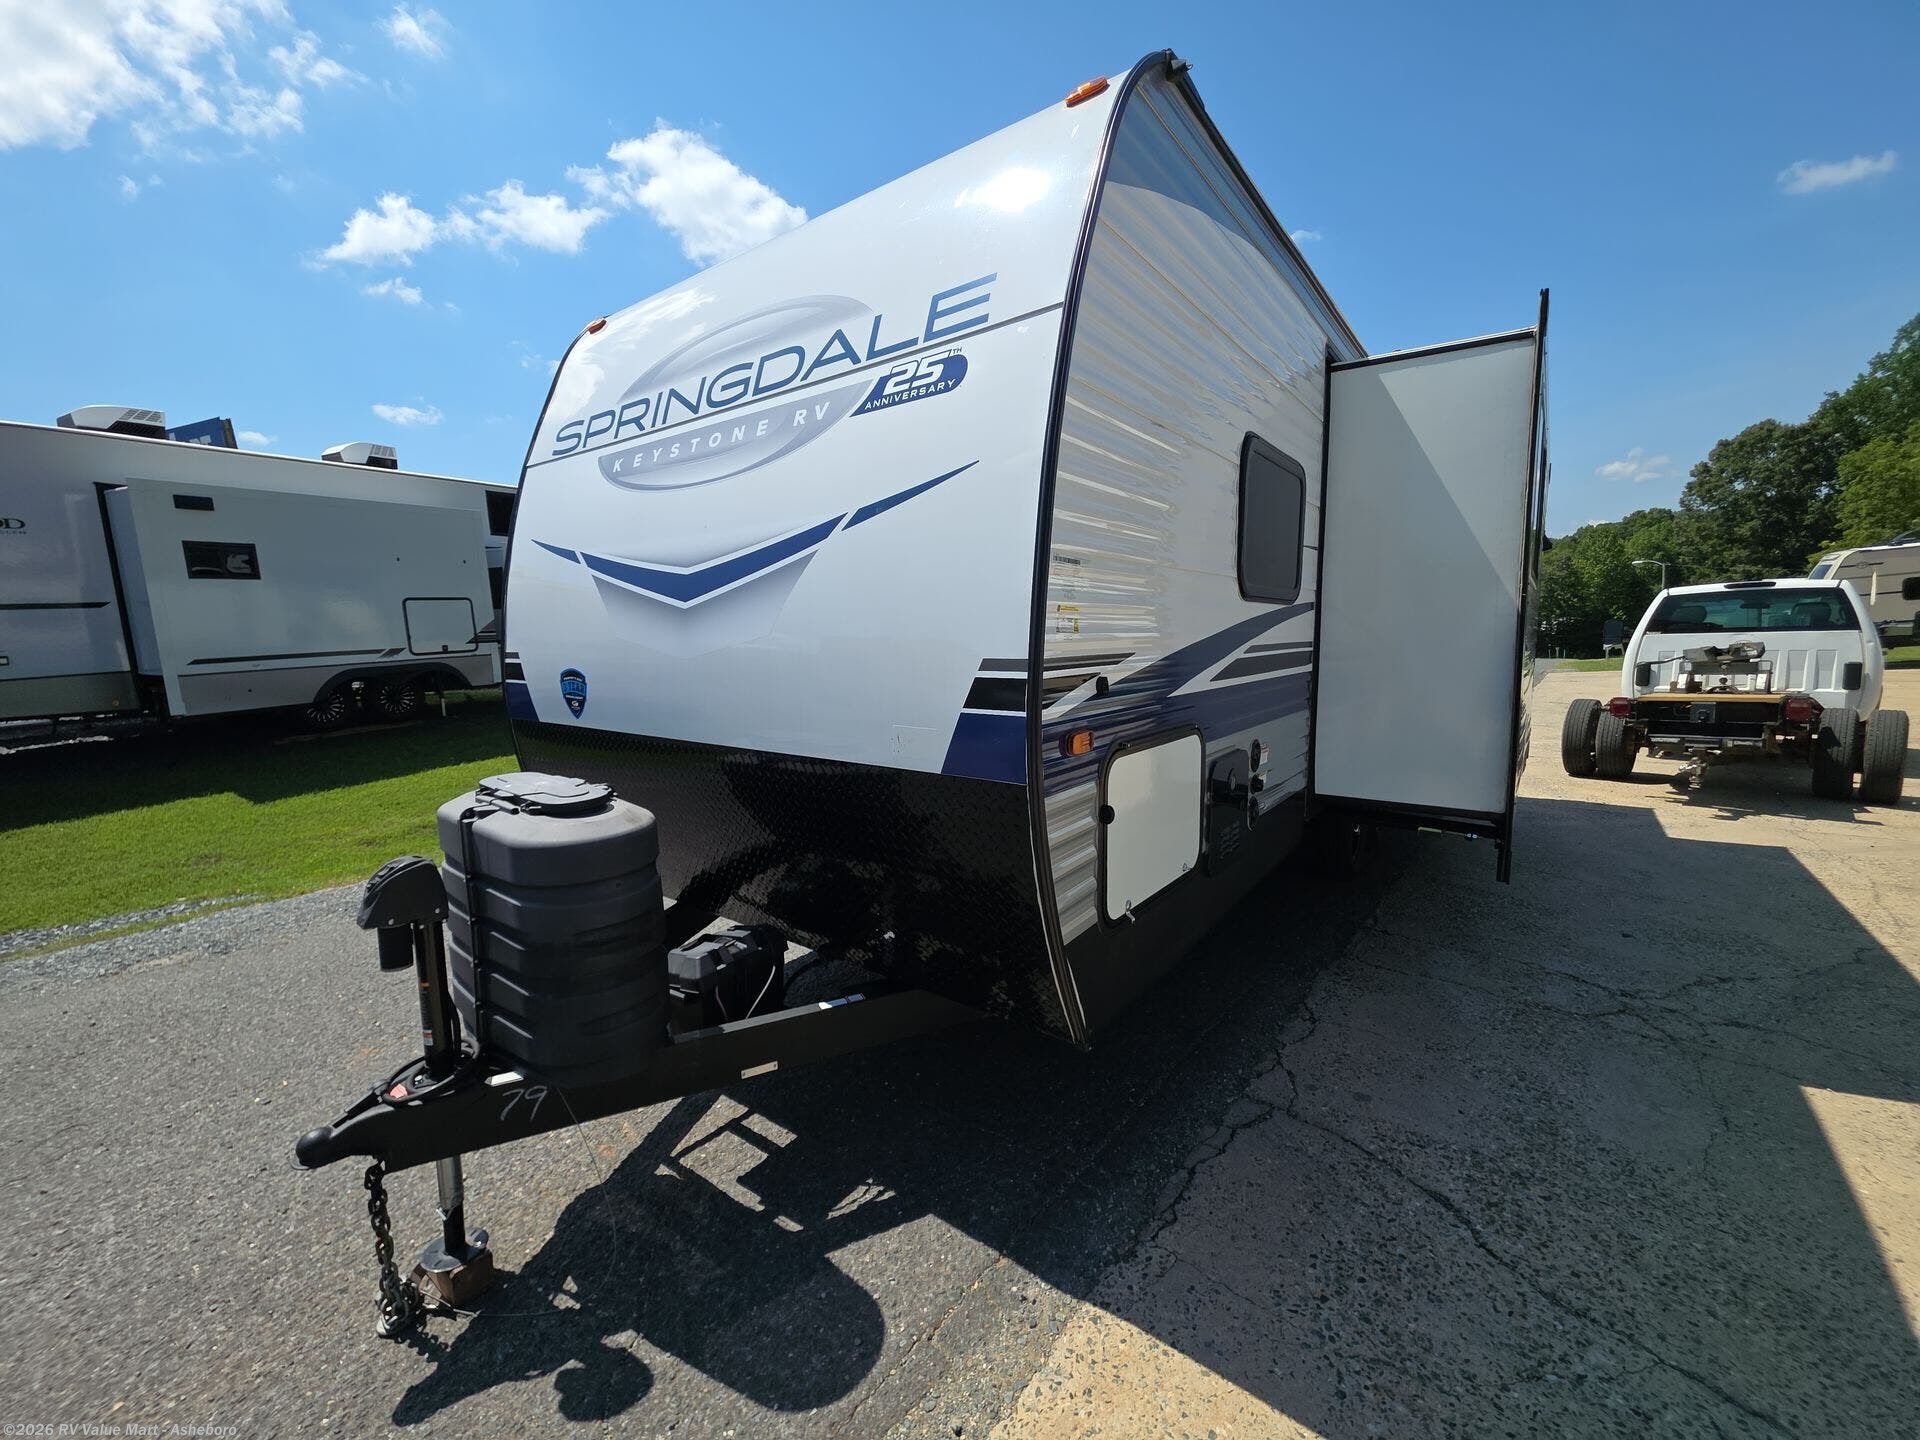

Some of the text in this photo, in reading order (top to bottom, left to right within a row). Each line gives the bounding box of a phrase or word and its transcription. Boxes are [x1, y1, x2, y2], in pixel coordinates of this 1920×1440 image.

[552, 272, 998, 456] SPRINGDALE
[864, 378, 956, 410] ANNIVERSARY
[612, 401, 830, 473] KEYSTONE RV
[500, 1085, 547, 1122] 79
